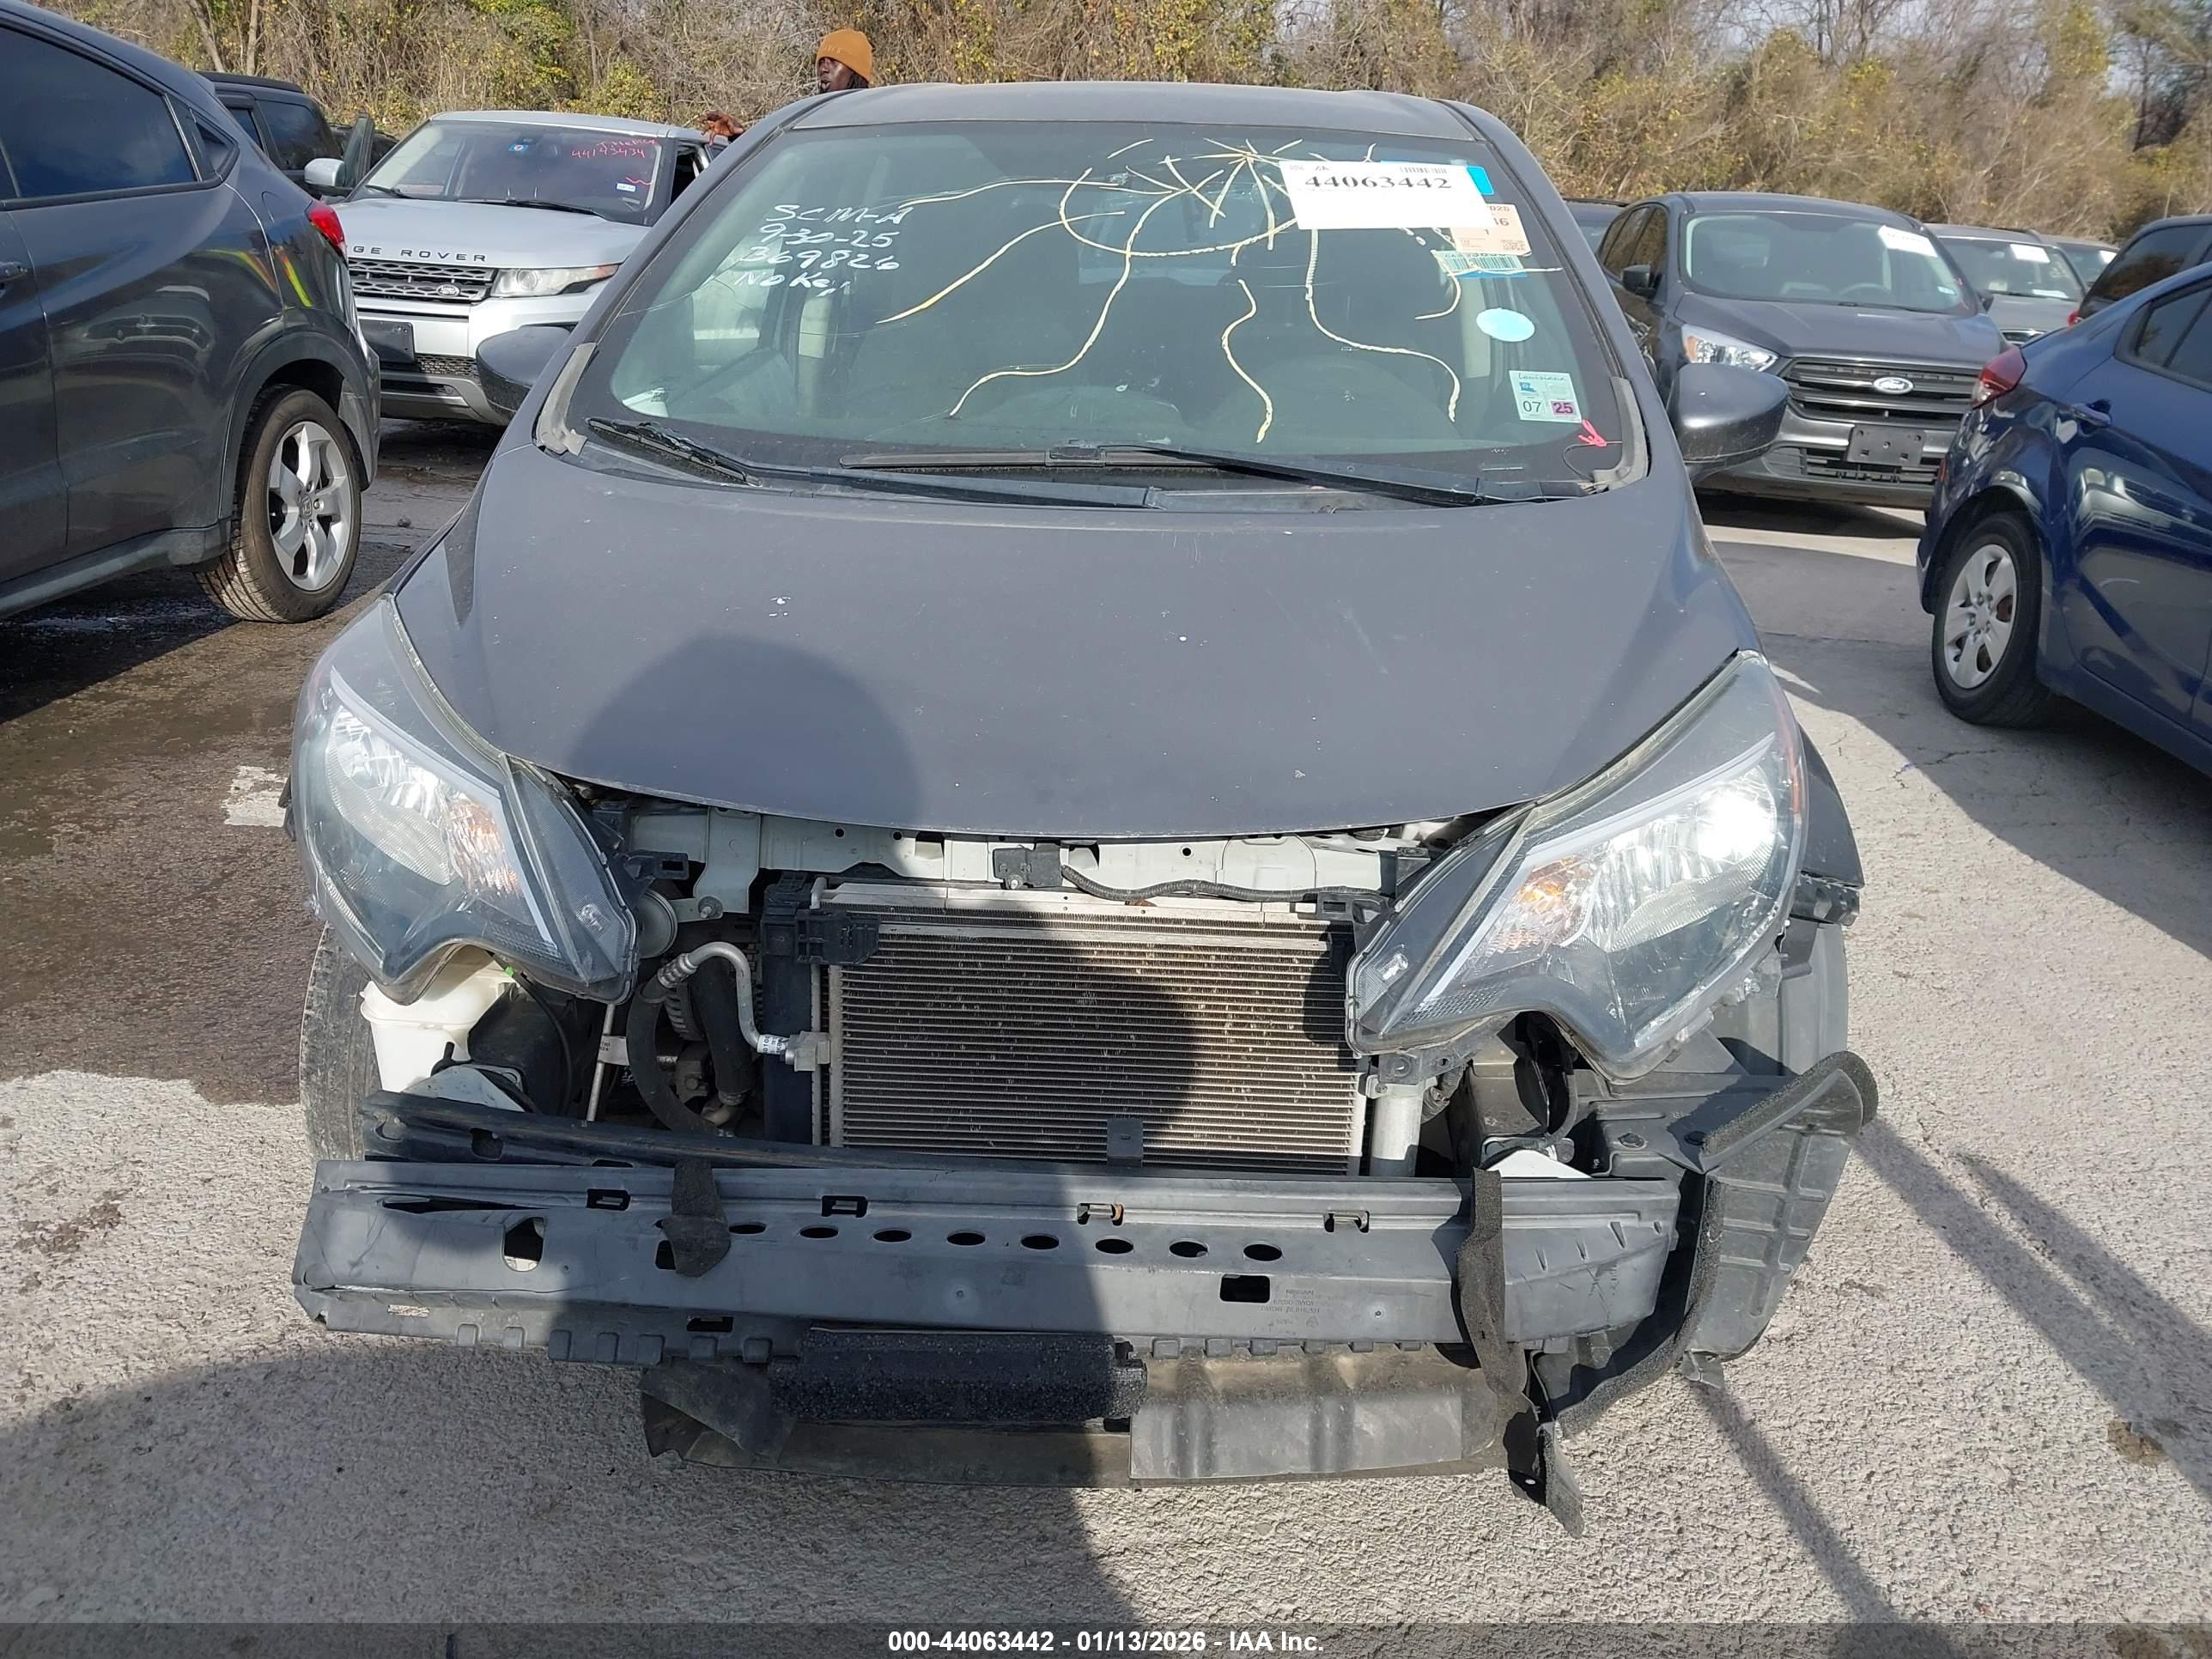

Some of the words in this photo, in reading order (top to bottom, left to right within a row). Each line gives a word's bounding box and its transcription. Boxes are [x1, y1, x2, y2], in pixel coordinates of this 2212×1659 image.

[1304, 175, 1452, 189] 44063442
[759, 222, 901, 247] 9-30-25
[400, 249, 486, 262] ROVER
[739, 246, 900, 270] 369826
[1522, 400, 1541, 412] 07
[1553, 402, 1573, 414] 25
